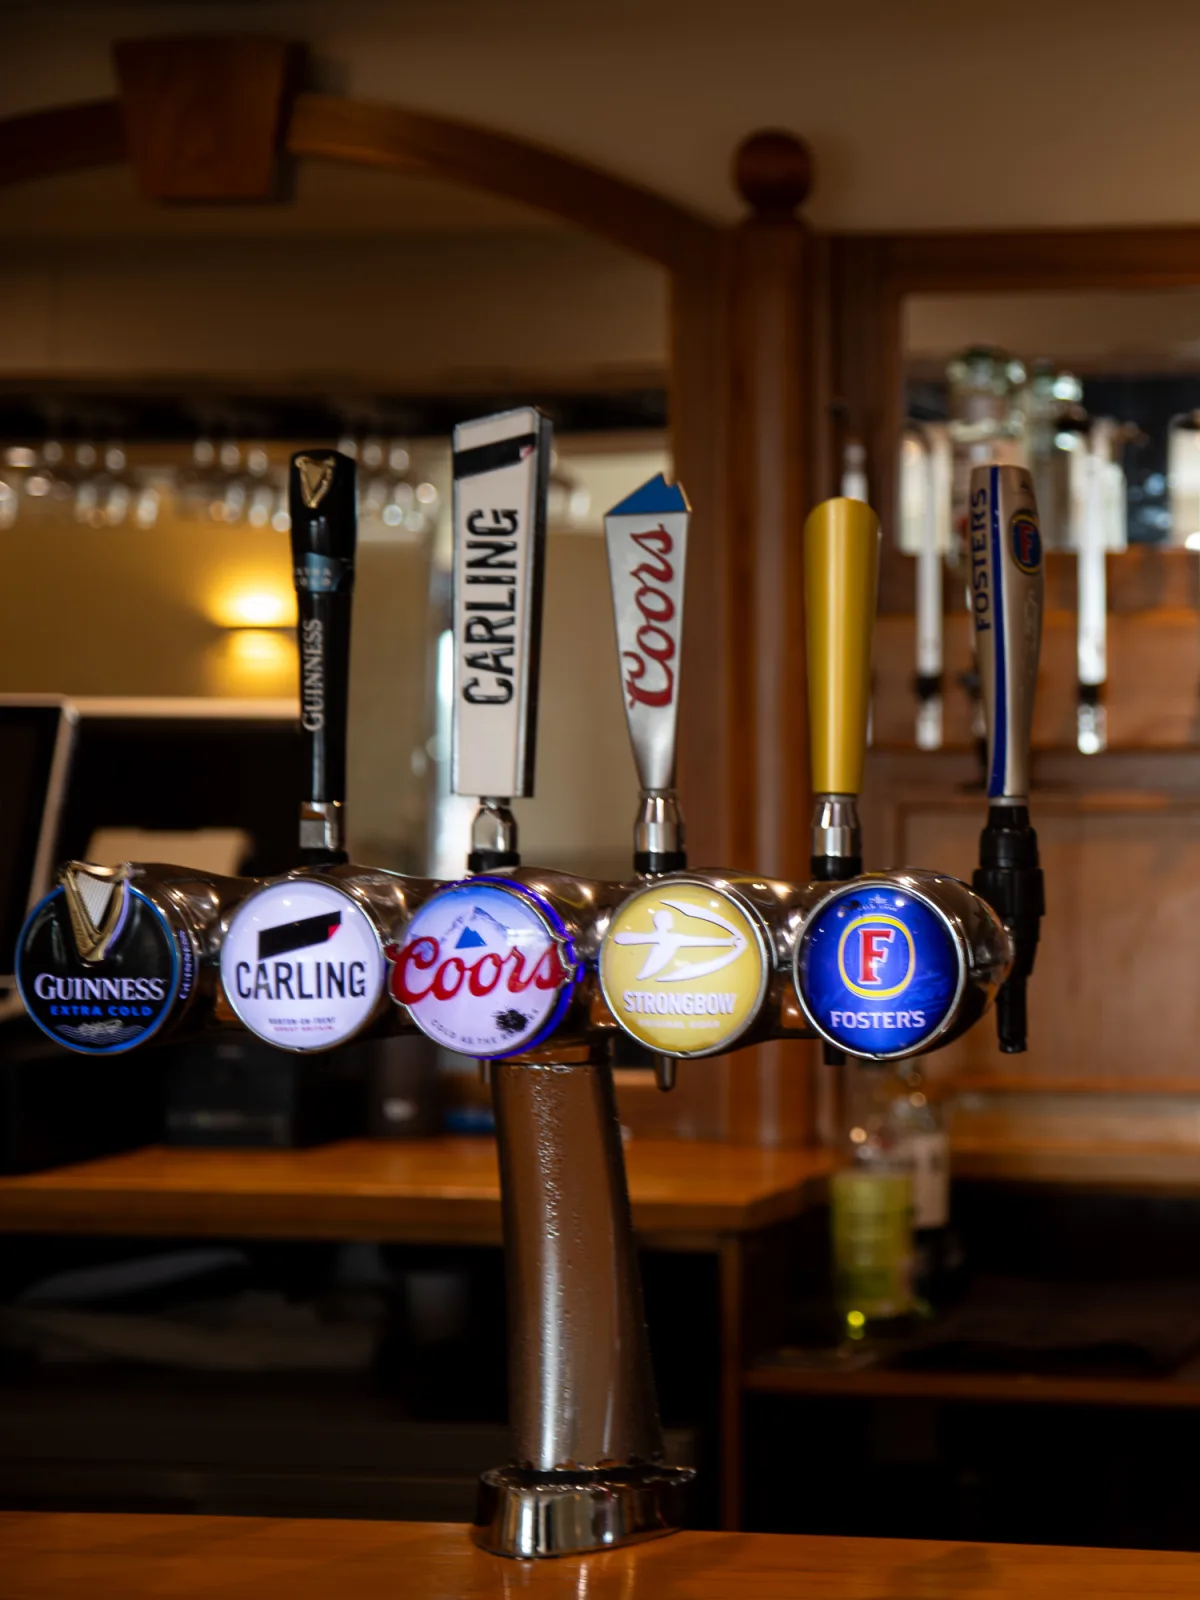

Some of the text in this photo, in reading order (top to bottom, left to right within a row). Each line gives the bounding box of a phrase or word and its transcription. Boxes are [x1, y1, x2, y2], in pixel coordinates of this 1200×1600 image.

[462, 508, 518, 706] CARLING
[622, 523, 675, 709] Coors
[302, 619, 323, 732] GUINNESS
[236, 961, 366, 1000] CARLING
[386, 936, 569, 1006] Coors
[858, 928, 895, 985] F
[34, 972, 165, 1000] GUINNESS
[622, 990, 736, 1015] STRONGBOW
[49, 1005, 153, 1016] EXTRA COLD
[830, 1010, 926, 1029] FOSTER'S
